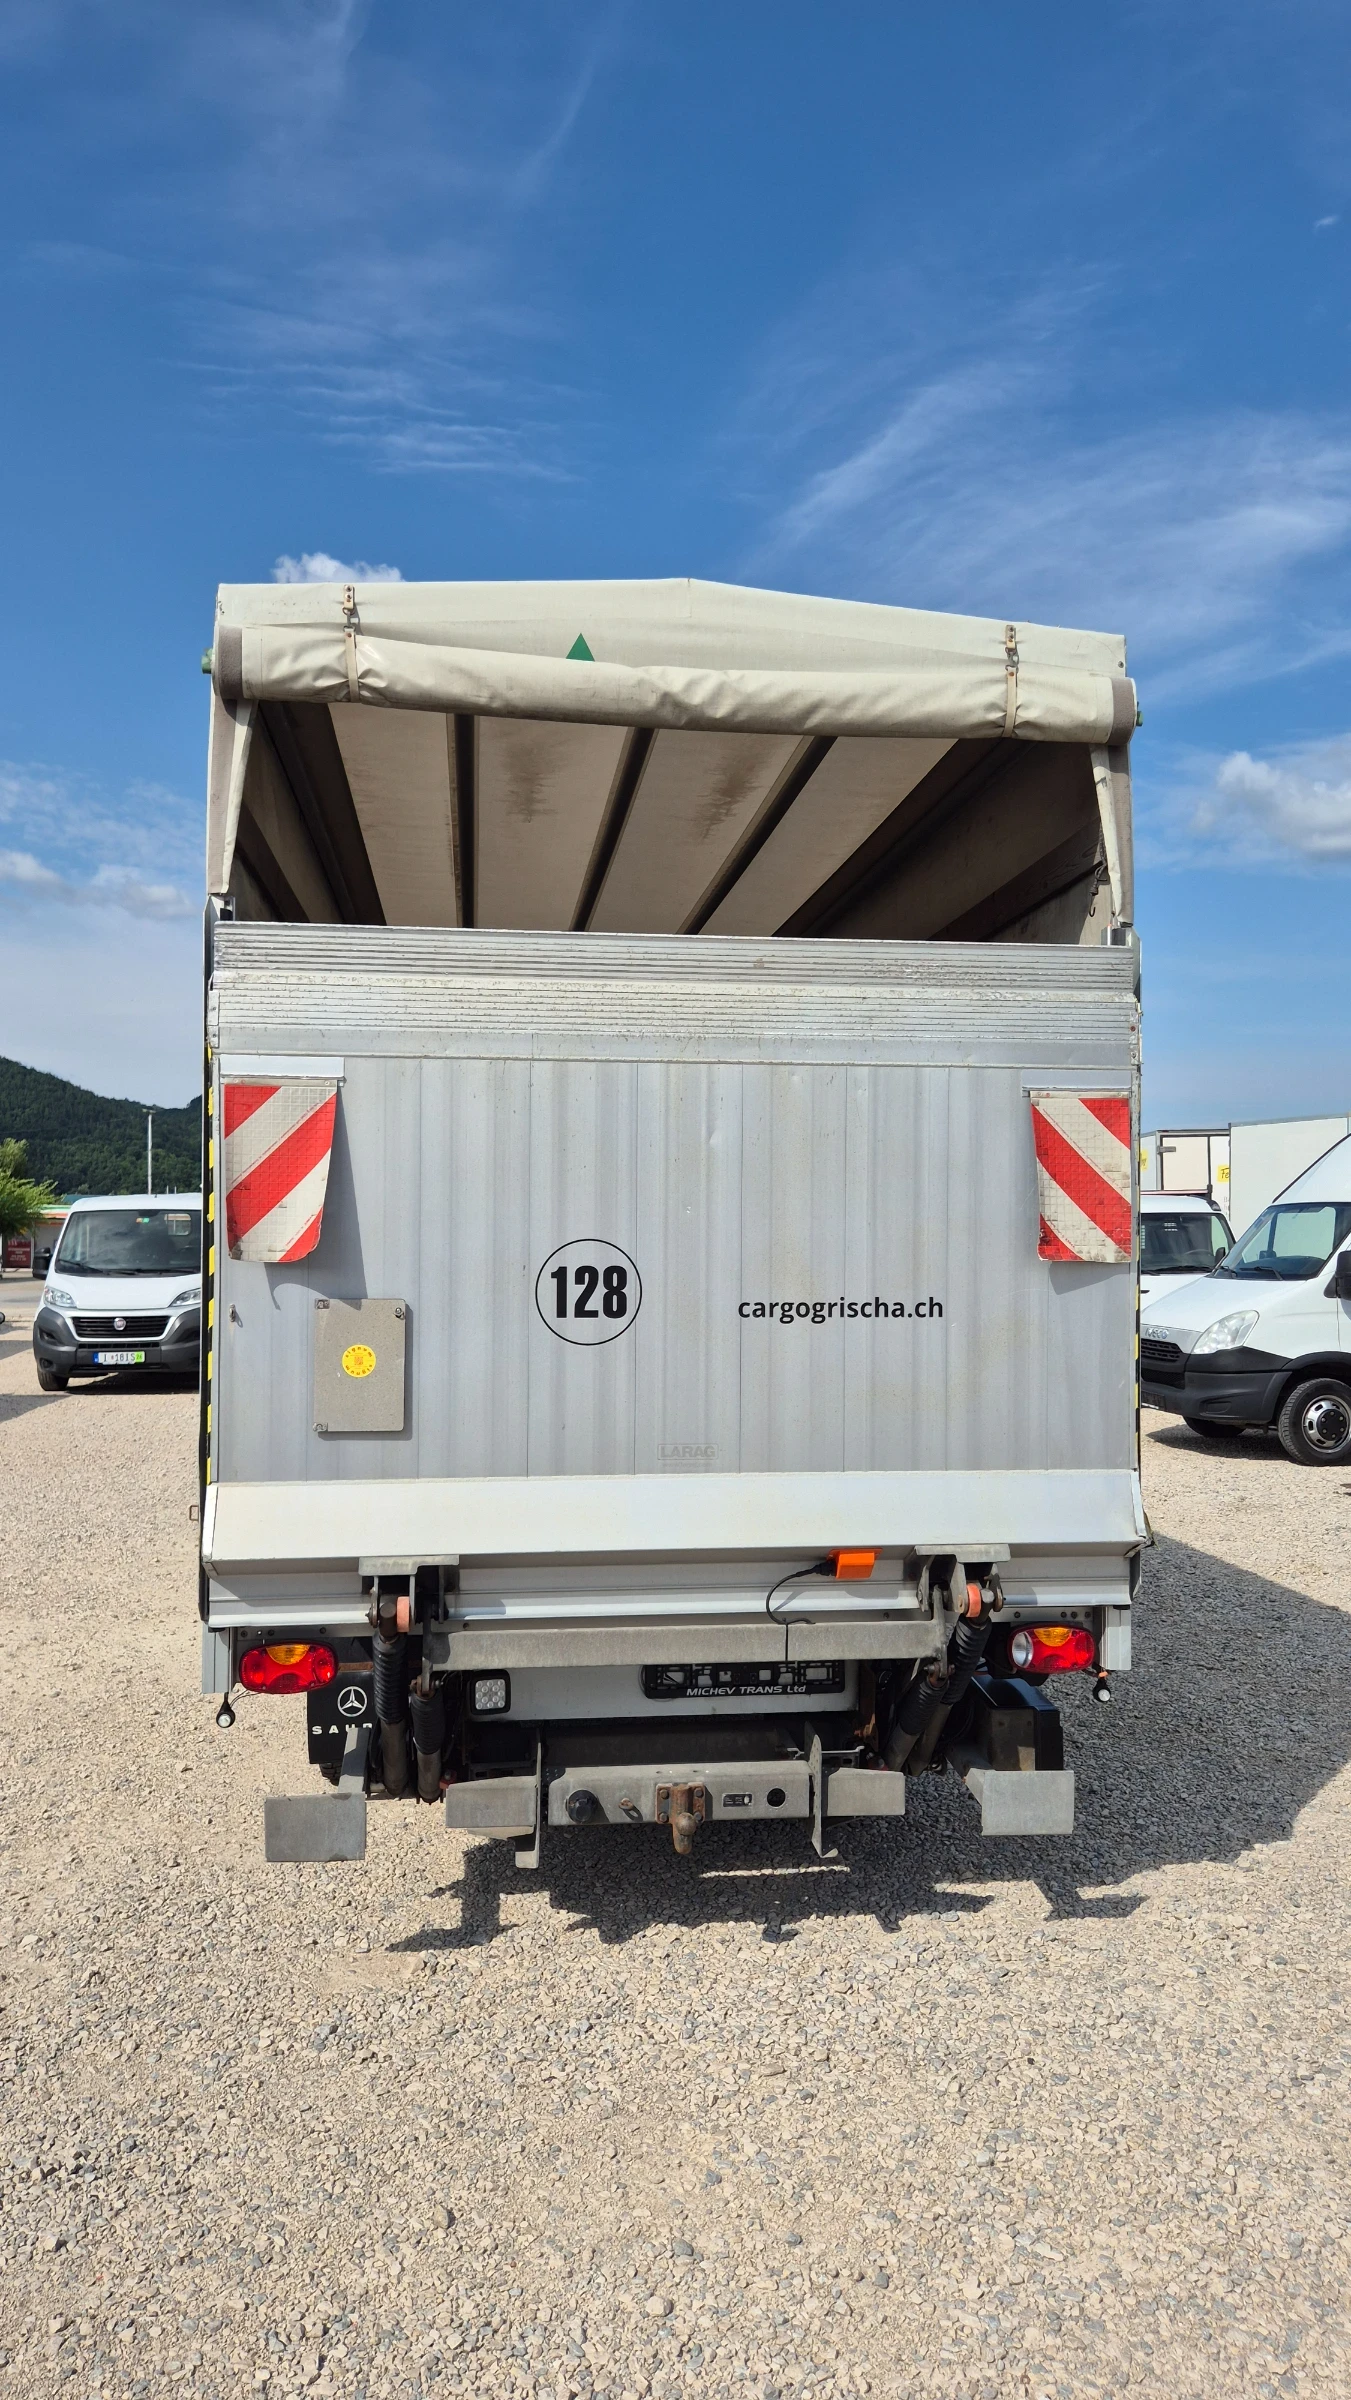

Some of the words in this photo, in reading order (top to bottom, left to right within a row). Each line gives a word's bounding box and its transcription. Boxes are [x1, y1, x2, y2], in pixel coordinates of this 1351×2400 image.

[551, 1265, 627, 1319] 128
[738, 1297, 943, 1324] cargogrischa.ch
[661, 1446, 715, 1458] LARAG
[687, 1687, 735, 1696] MICHEV
[740, 1686, 783, 1694] TRANS
[787, 1685, 806, 1693] Ltd
